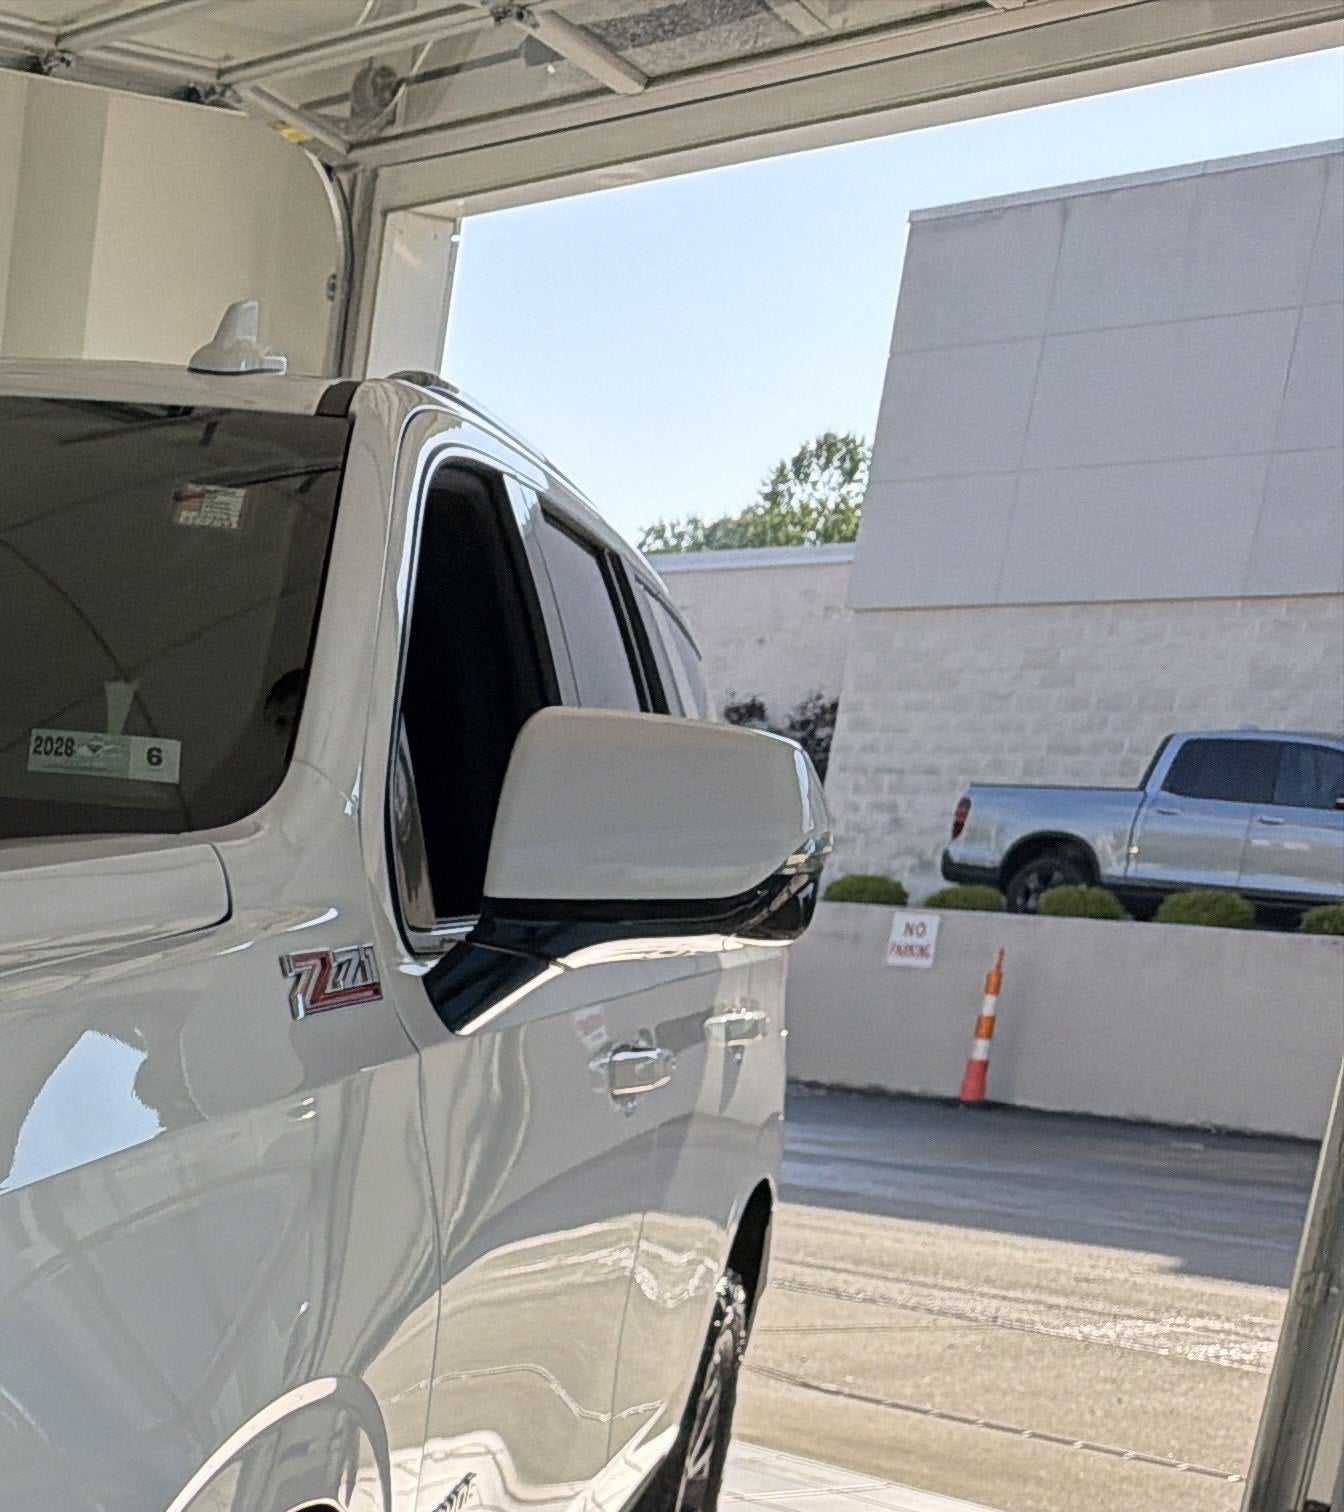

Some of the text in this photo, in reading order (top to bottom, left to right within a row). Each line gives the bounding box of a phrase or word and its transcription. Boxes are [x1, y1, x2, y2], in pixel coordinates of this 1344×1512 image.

[32, 735, 163, 767] 2028 6
[904, 920, 927, 939] NO
[279, 942, 383, 1021] Z71
